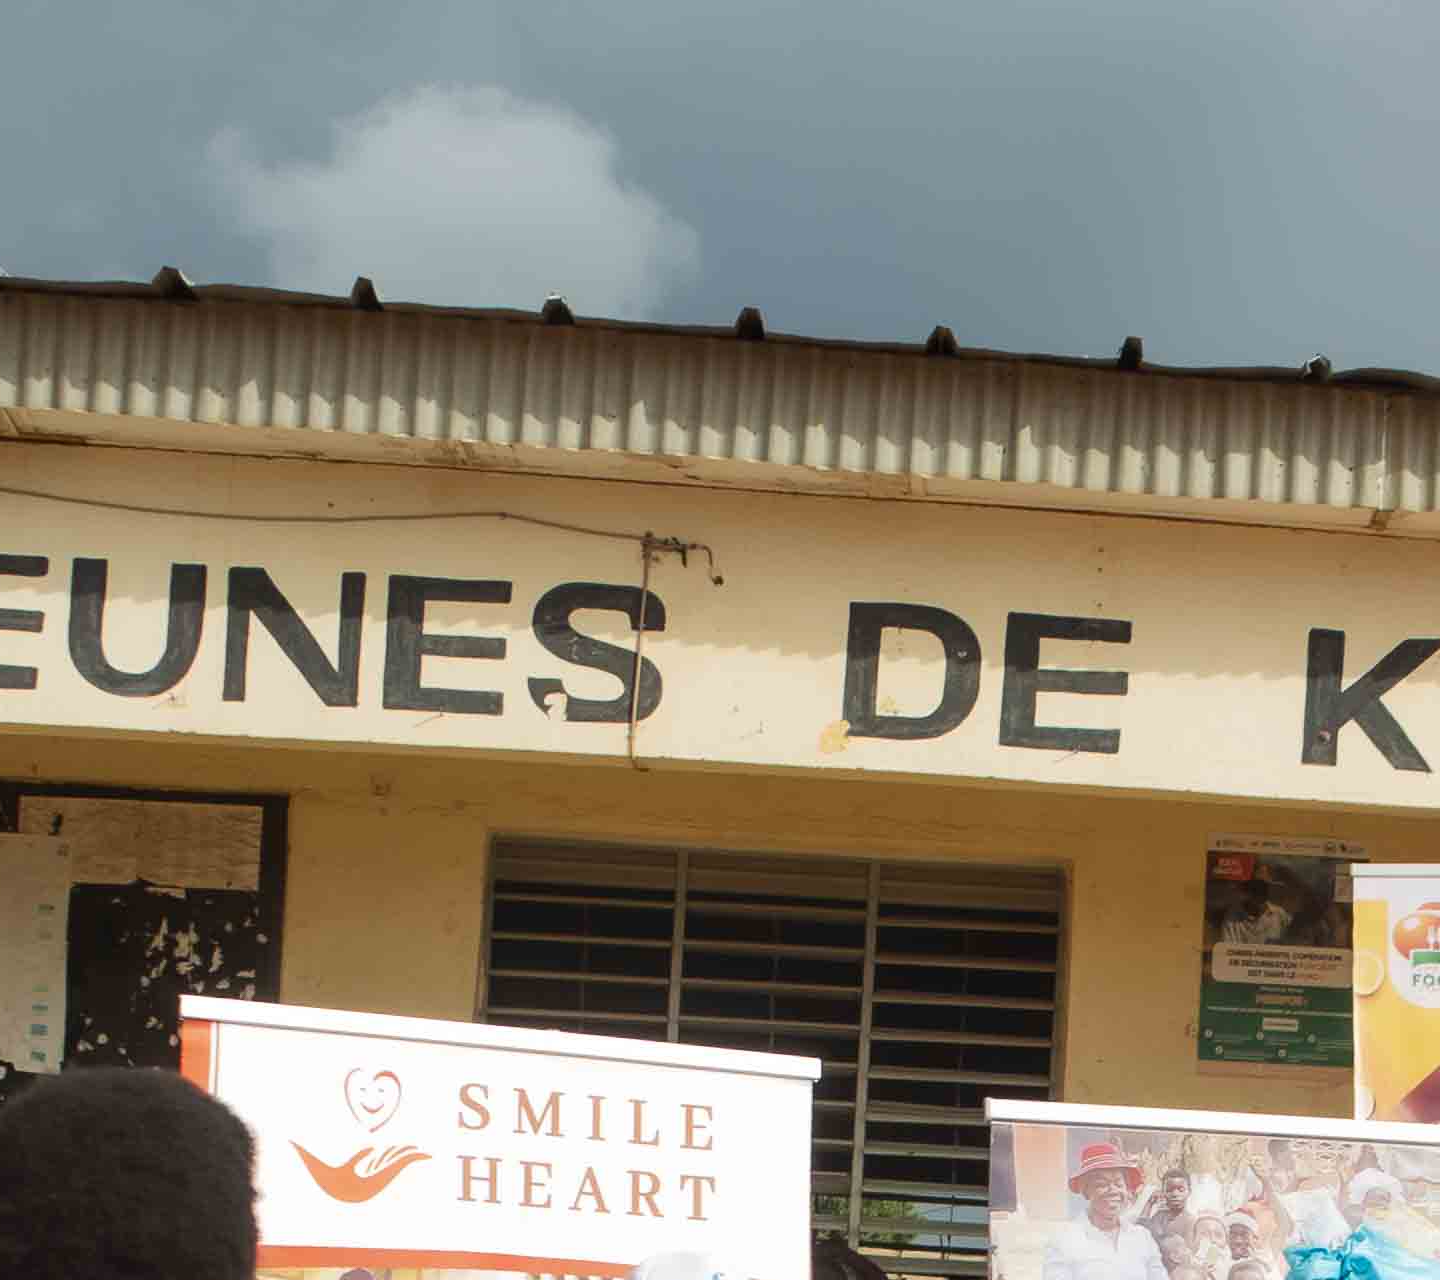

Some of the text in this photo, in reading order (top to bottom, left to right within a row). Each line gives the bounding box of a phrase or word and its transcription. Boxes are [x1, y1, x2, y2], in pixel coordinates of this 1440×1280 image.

[846, 600, 1134, 754] DE
[456, 1082, 715, 1152] SMILE
[456, 1154, 717, 1222] HEART
